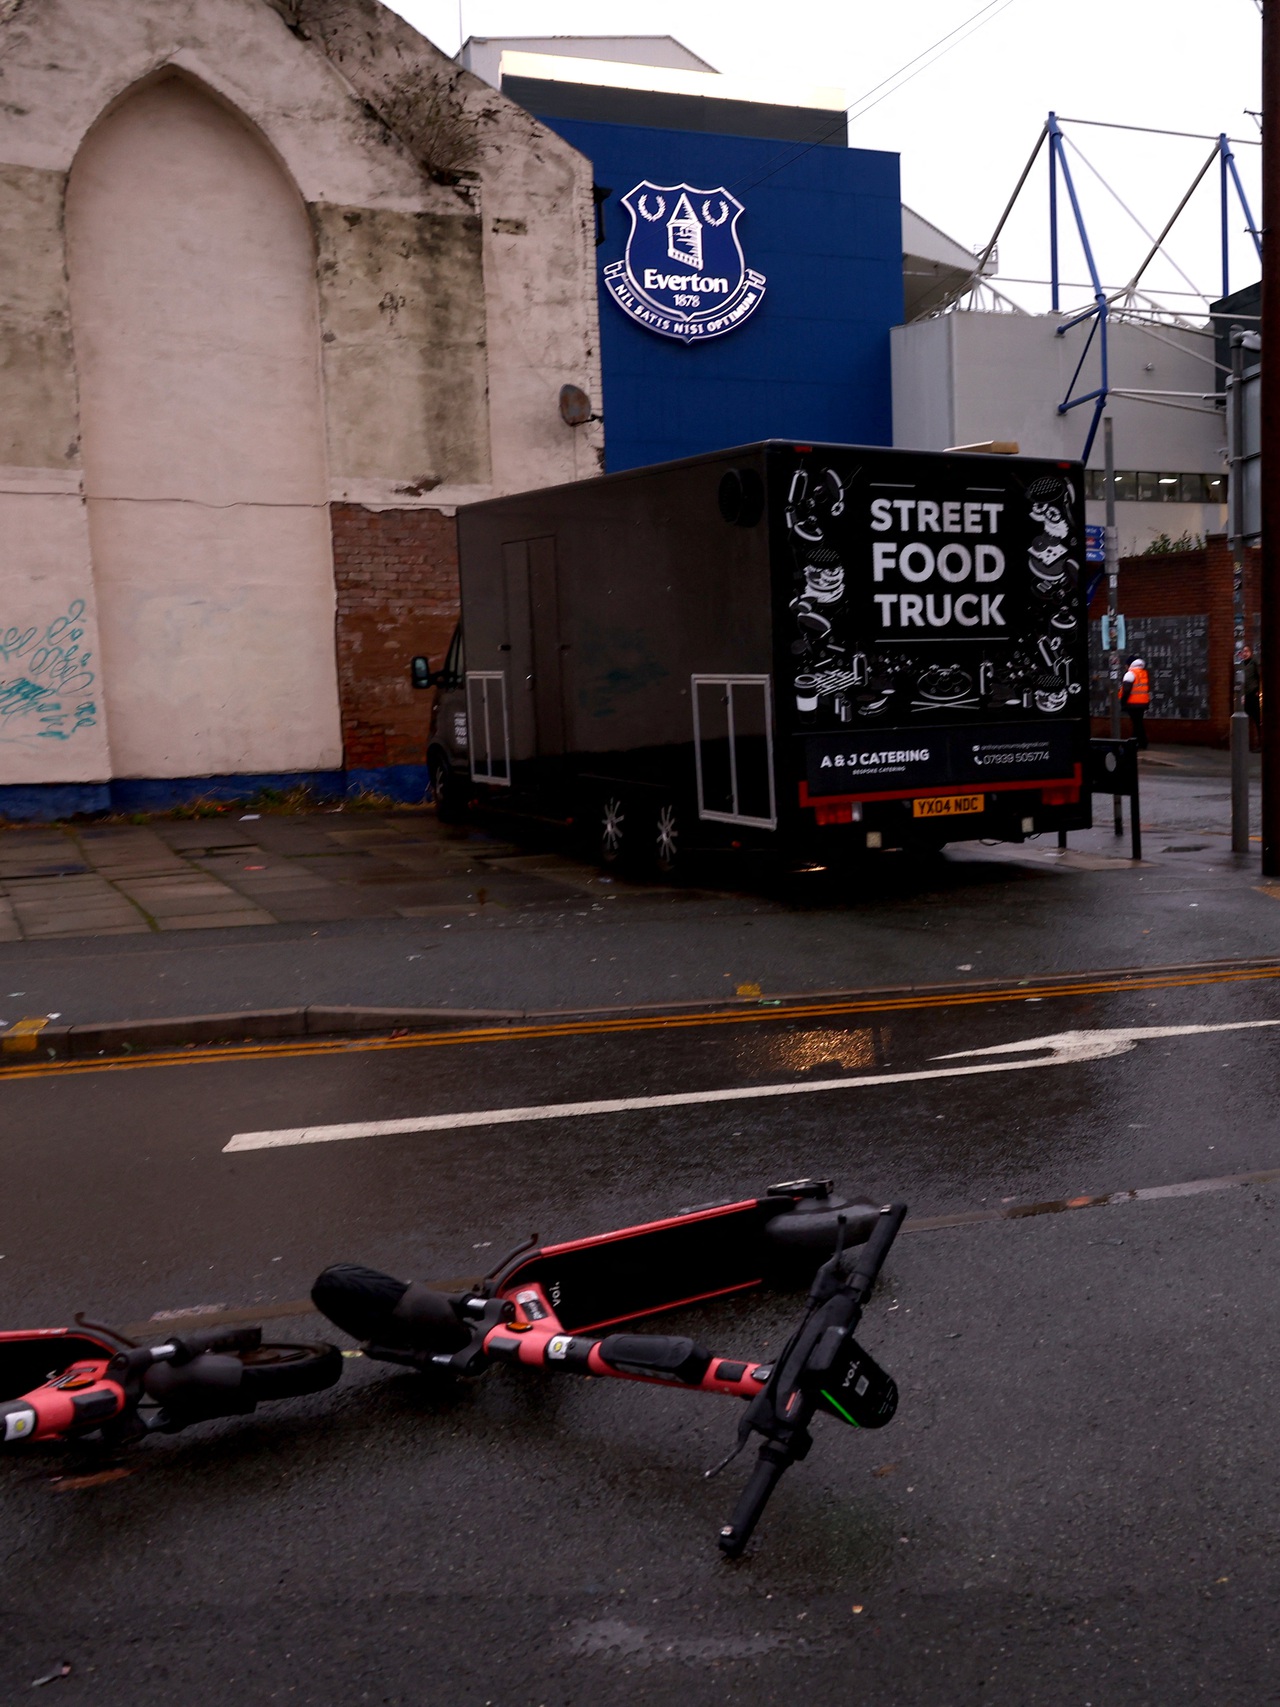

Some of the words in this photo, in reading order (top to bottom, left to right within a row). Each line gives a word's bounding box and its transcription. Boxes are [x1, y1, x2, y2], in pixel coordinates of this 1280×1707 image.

[643, 268, 729, 294] Everton
[614, 283, 634, 308] NIL
[633, 305, 671, 331] SATIS
[673, 322, 705, 335] NISI
[706, 291, 758, 332] OPTIMUM
[672, 293, 701, 308] 1878
[870, 498, 1004, 534] STREET
[872, 542, 1006, 583] FOOD
[873, 593, 1007, 628] TRUCK
[820, 755, 833, 769] A
[834, 754, 846, 768] &
[847, 753, 858, 767] J
[859, 748, 930, 766] CATERING
[879, 765, 906, 774] CATERING
[918, 799, 951, 815] YX04
[954, 797, 979, 812] NDC
